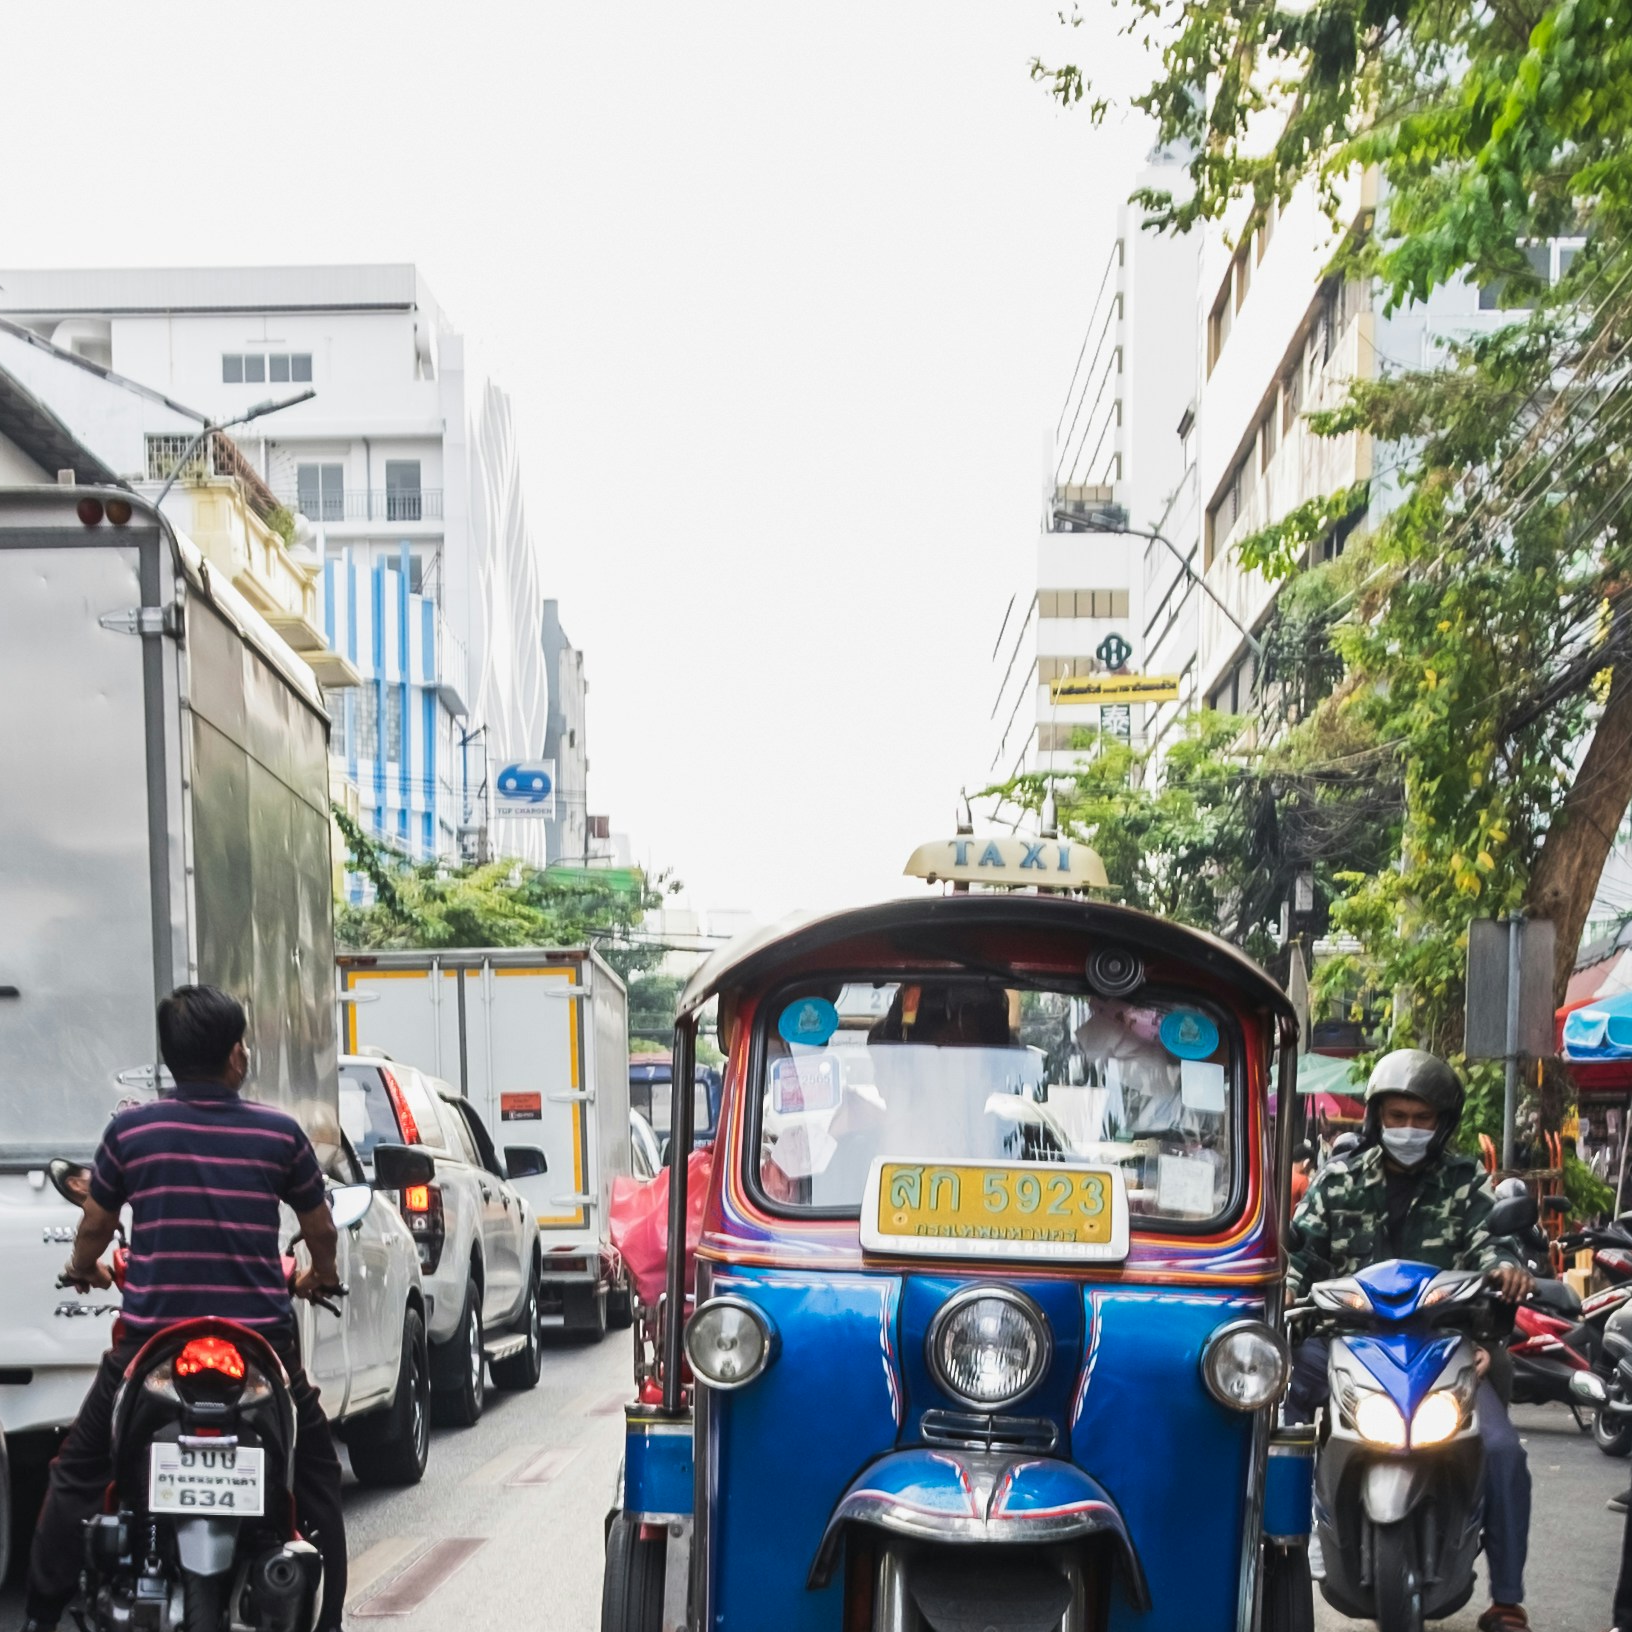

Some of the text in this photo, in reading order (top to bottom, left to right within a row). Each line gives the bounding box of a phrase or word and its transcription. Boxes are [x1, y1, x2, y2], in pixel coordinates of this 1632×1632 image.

[948, 840, 1071, 871] TAXI
[889, 1167, 1106, 1217] สก 5923
[913, 1223, 1077, 1242] กรุงเทพมหานคร
[179, 1489, 236, 1508] 634
